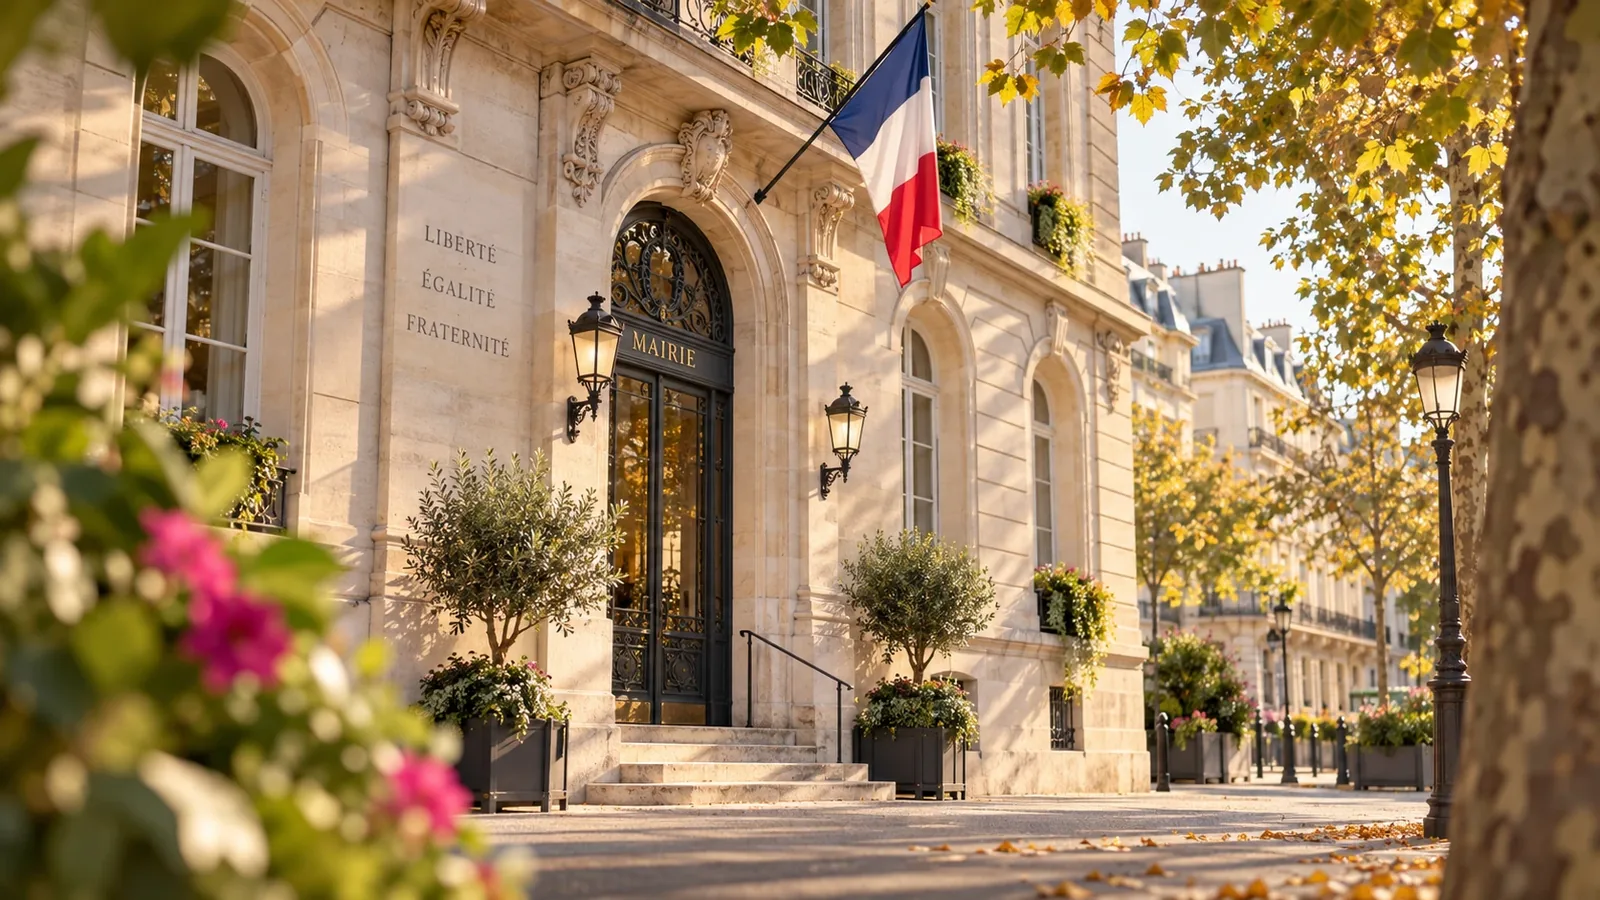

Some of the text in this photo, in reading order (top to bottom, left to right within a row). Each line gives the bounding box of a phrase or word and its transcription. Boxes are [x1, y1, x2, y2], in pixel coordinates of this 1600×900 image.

[425, 225, 496, 264] LIBERTÉ
[421, 268, 495, 309] ÉGALITÉ
[406, 313, 509, 358] FRATERNITÉ
[632, 330, 696, 368] MAIRIE
